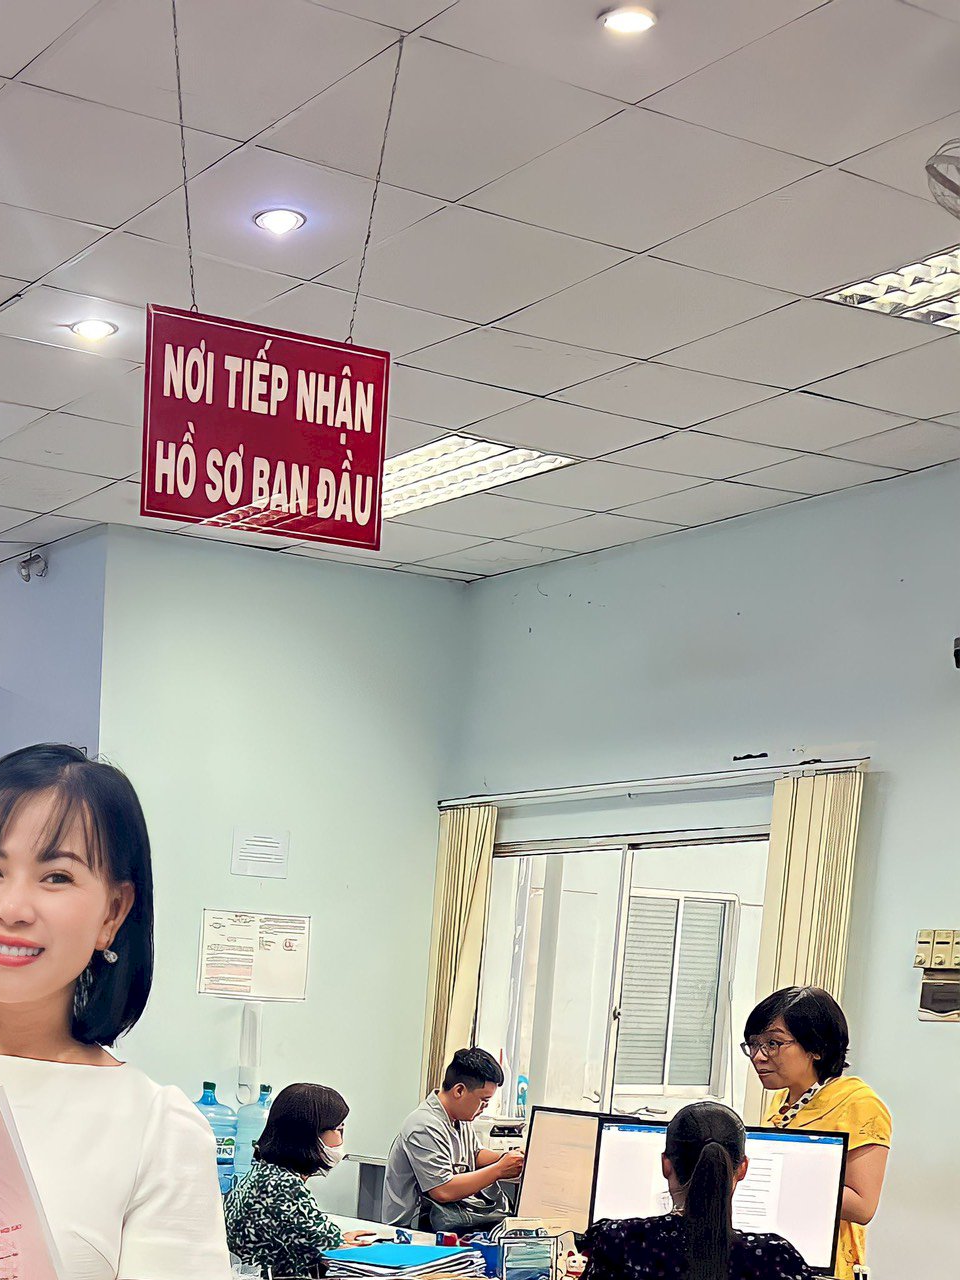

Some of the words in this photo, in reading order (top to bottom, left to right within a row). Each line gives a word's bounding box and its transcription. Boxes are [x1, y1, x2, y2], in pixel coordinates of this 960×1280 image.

[163, 340, 215, 404] NƠI
[224, 340, 289, 416] TIẾP
[296, 366, 374, 444] NHẬN
[154, 422, 197, 499] HỒ
[204, 444, 244, 505] SƠ
[252, 457, 310, 516] BAN
[317, 450, 373, 525] ĐẦU
